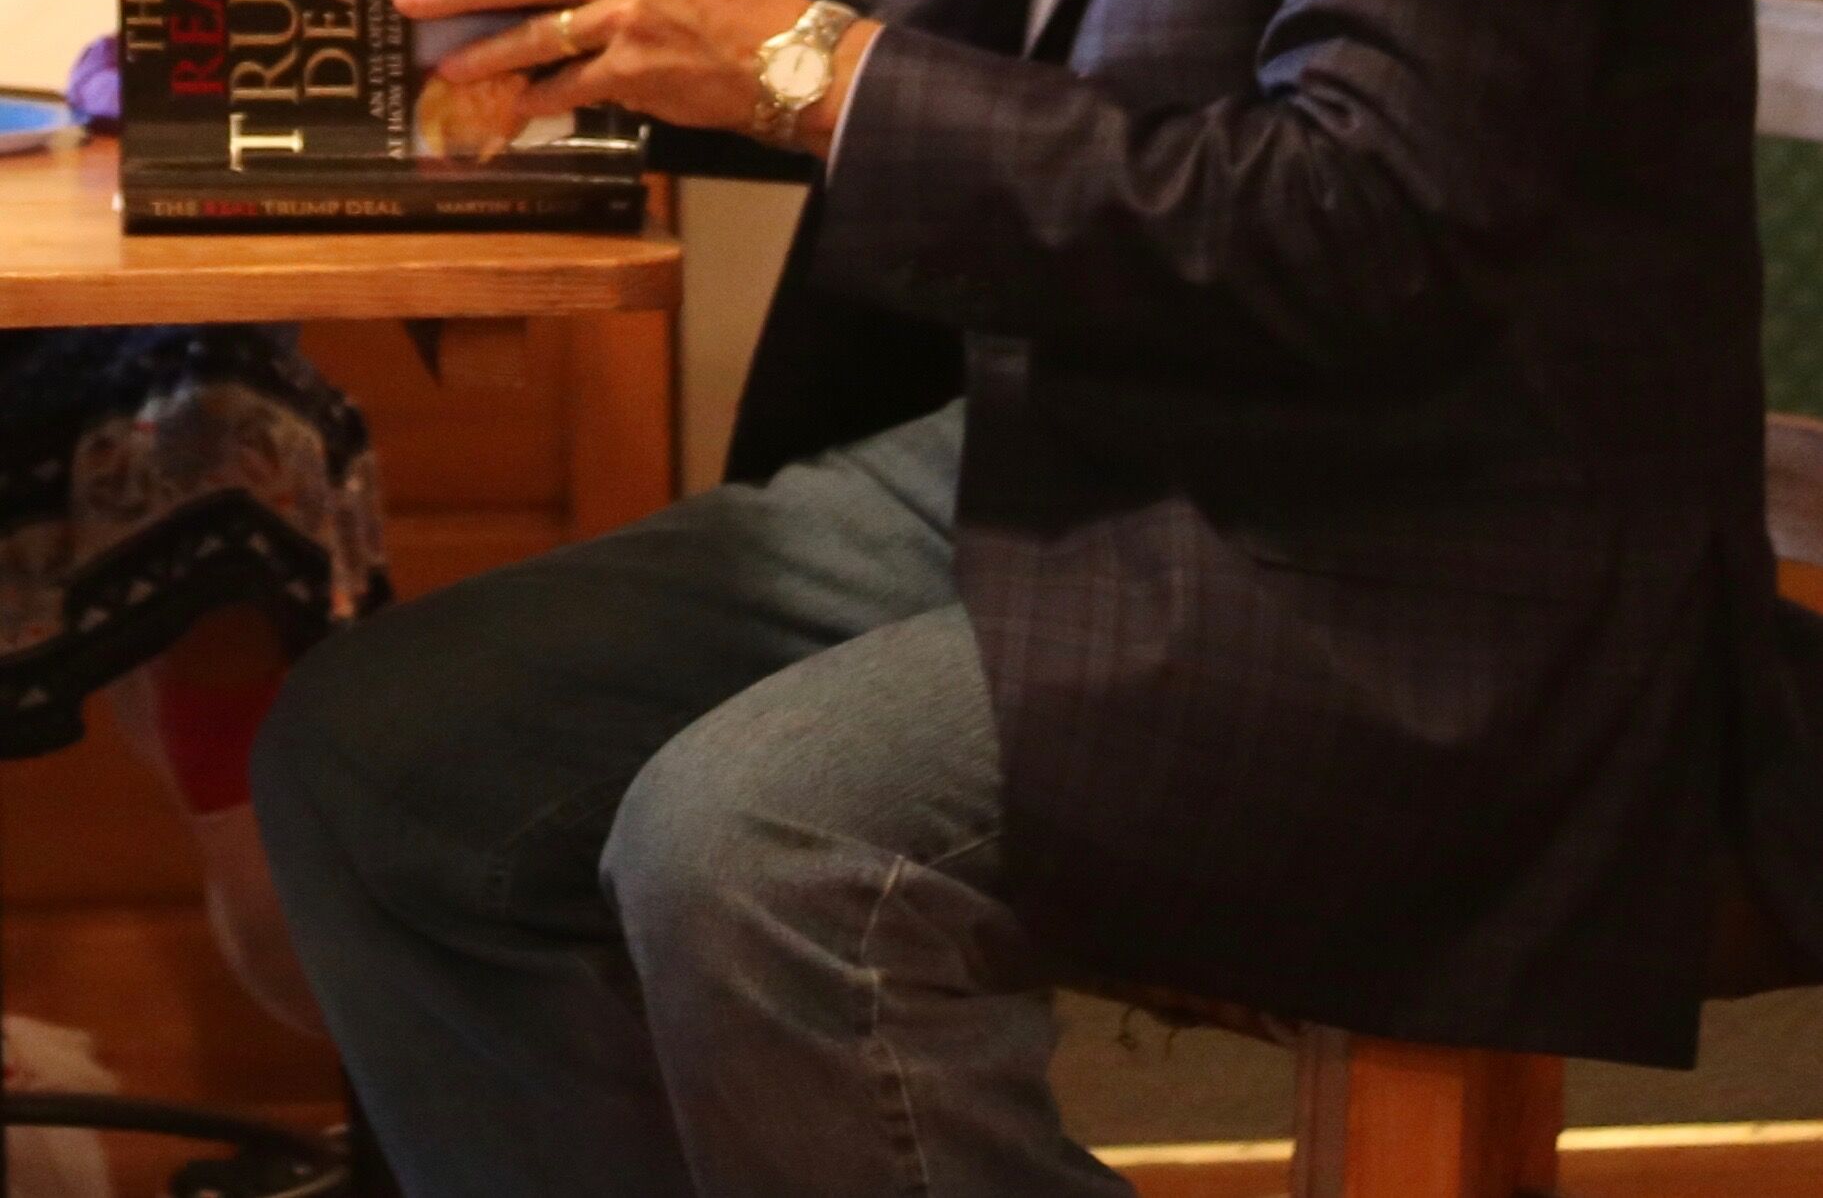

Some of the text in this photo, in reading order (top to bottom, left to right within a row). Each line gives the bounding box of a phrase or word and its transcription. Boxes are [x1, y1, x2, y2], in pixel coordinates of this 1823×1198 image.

[369, 90, 384, 120] AN
[387, 84, 403, 131] HOW
[388, 136, 404, 160] AT
[152, 201, 200, 217] THE
[260, 201, 340, 216] TRUMP
[344, 201, 404, 216] DEAL
